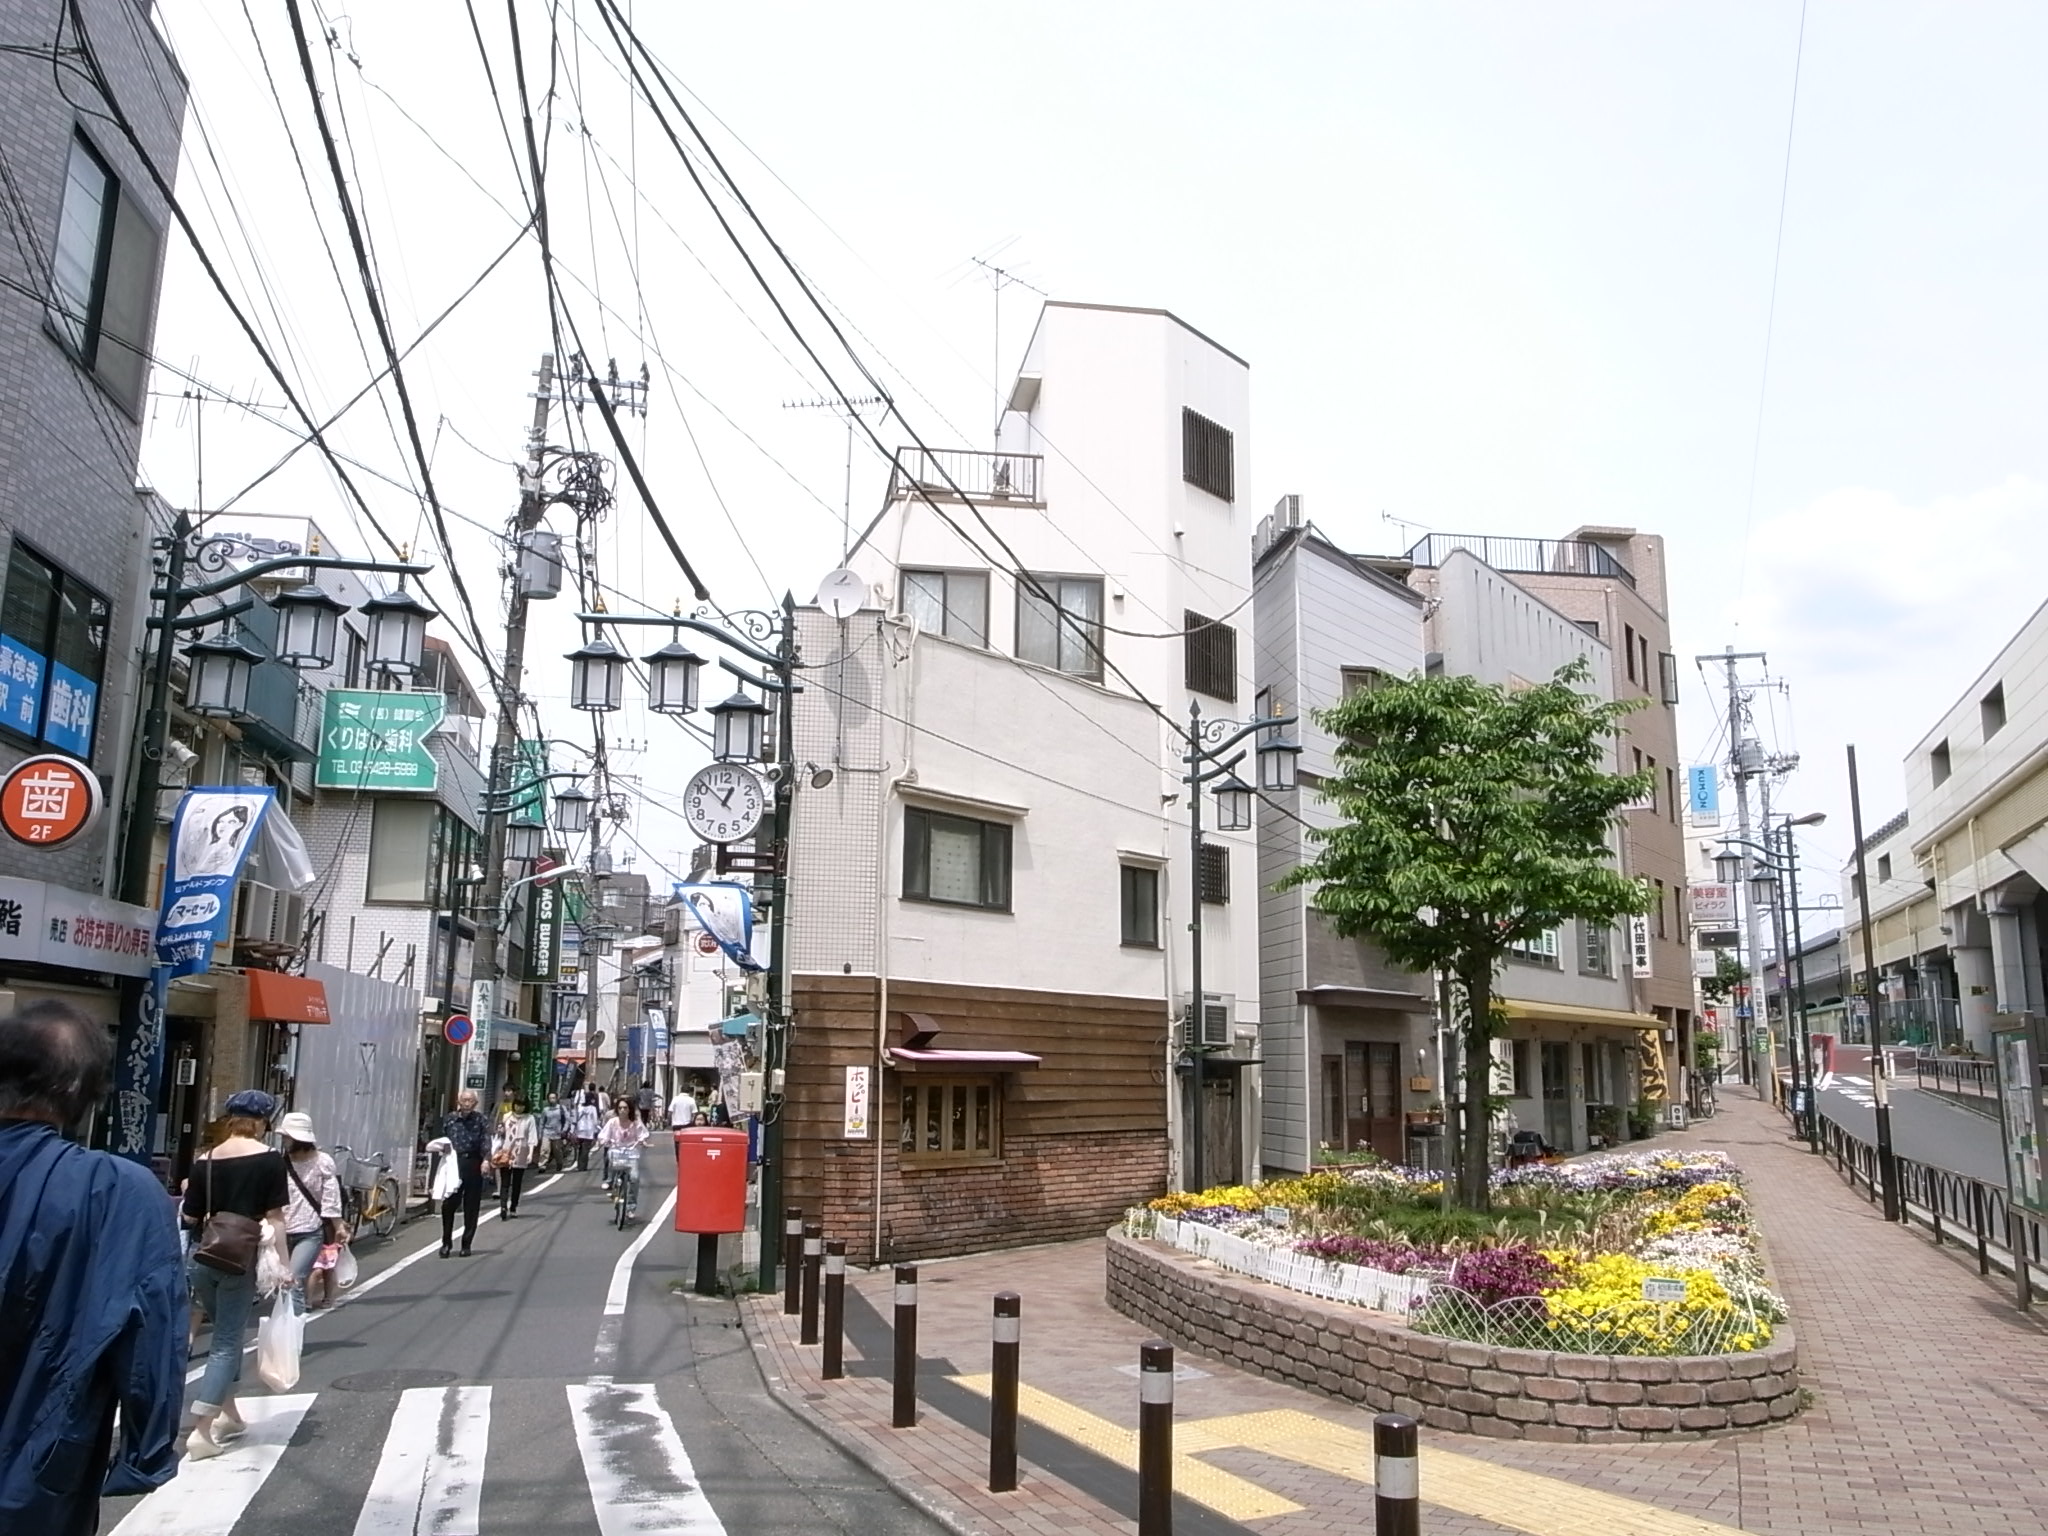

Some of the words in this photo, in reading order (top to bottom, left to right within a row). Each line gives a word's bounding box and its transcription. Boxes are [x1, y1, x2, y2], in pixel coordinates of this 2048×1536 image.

[50, 680, 91, 737] 歯科
[332, 760, 347, 774] TEL
[721, 772, 732, 784] 12
[21, 769, 75, 820] 歯
[694, 783, 708, 796] 10
[744, 785, 752, 796] 2
[1698, 769, 1708, 808] KUMON
[692, 797, 701, 808] 9
[746, 798, 755, 810] 3
[696, 809, 705, 820] 8
[741, 811, 750, 822] 4
[29, 824, 52, 839] 2F
[706, 820, 715, 831] 7
[718, 823, 727, 834] 6
[731, 820, 740, 831] 5
[1693, 887, 1728, 899] 美容室
[541, 888, 553, 920] MOS
[168, 901, 218, 921] マーセール
[49, 916, 68, 943] 売店
[73, 914, 150, 957] お持ち帰りの寿司
[537, 923, 551, 976] BURGER
[478, 983, 489, 1003] 八木
[850, 1071, 865, 1114] ホッピー
